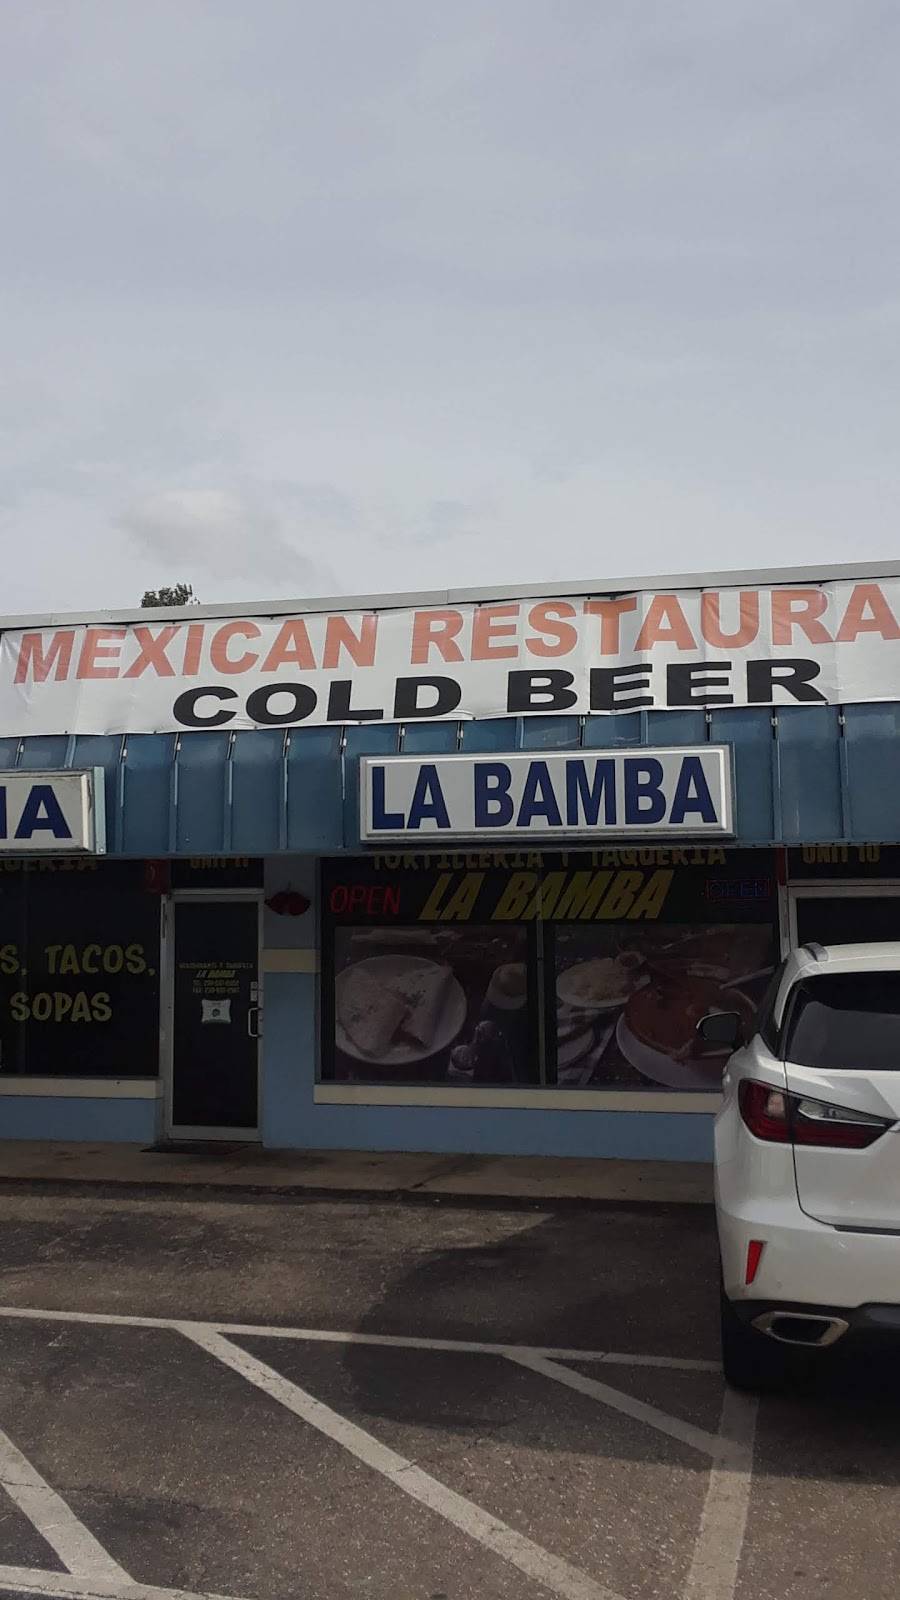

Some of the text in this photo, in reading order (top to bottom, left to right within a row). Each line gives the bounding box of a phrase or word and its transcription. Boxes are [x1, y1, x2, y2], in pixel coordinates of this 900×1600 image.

[13, 583, 900, 684] MEXICAN RESTAURA
[173, 659, 828, 727] COLD BEER
[372, 756, 718, 830] LA BAMBA
[328, 885, 401, 915] OPEN
[416, 869, 674, 921] LA BAMBA
[44, 943, 156, 976] TACOS,
[9, 992, 112, 1023] SOPAS
